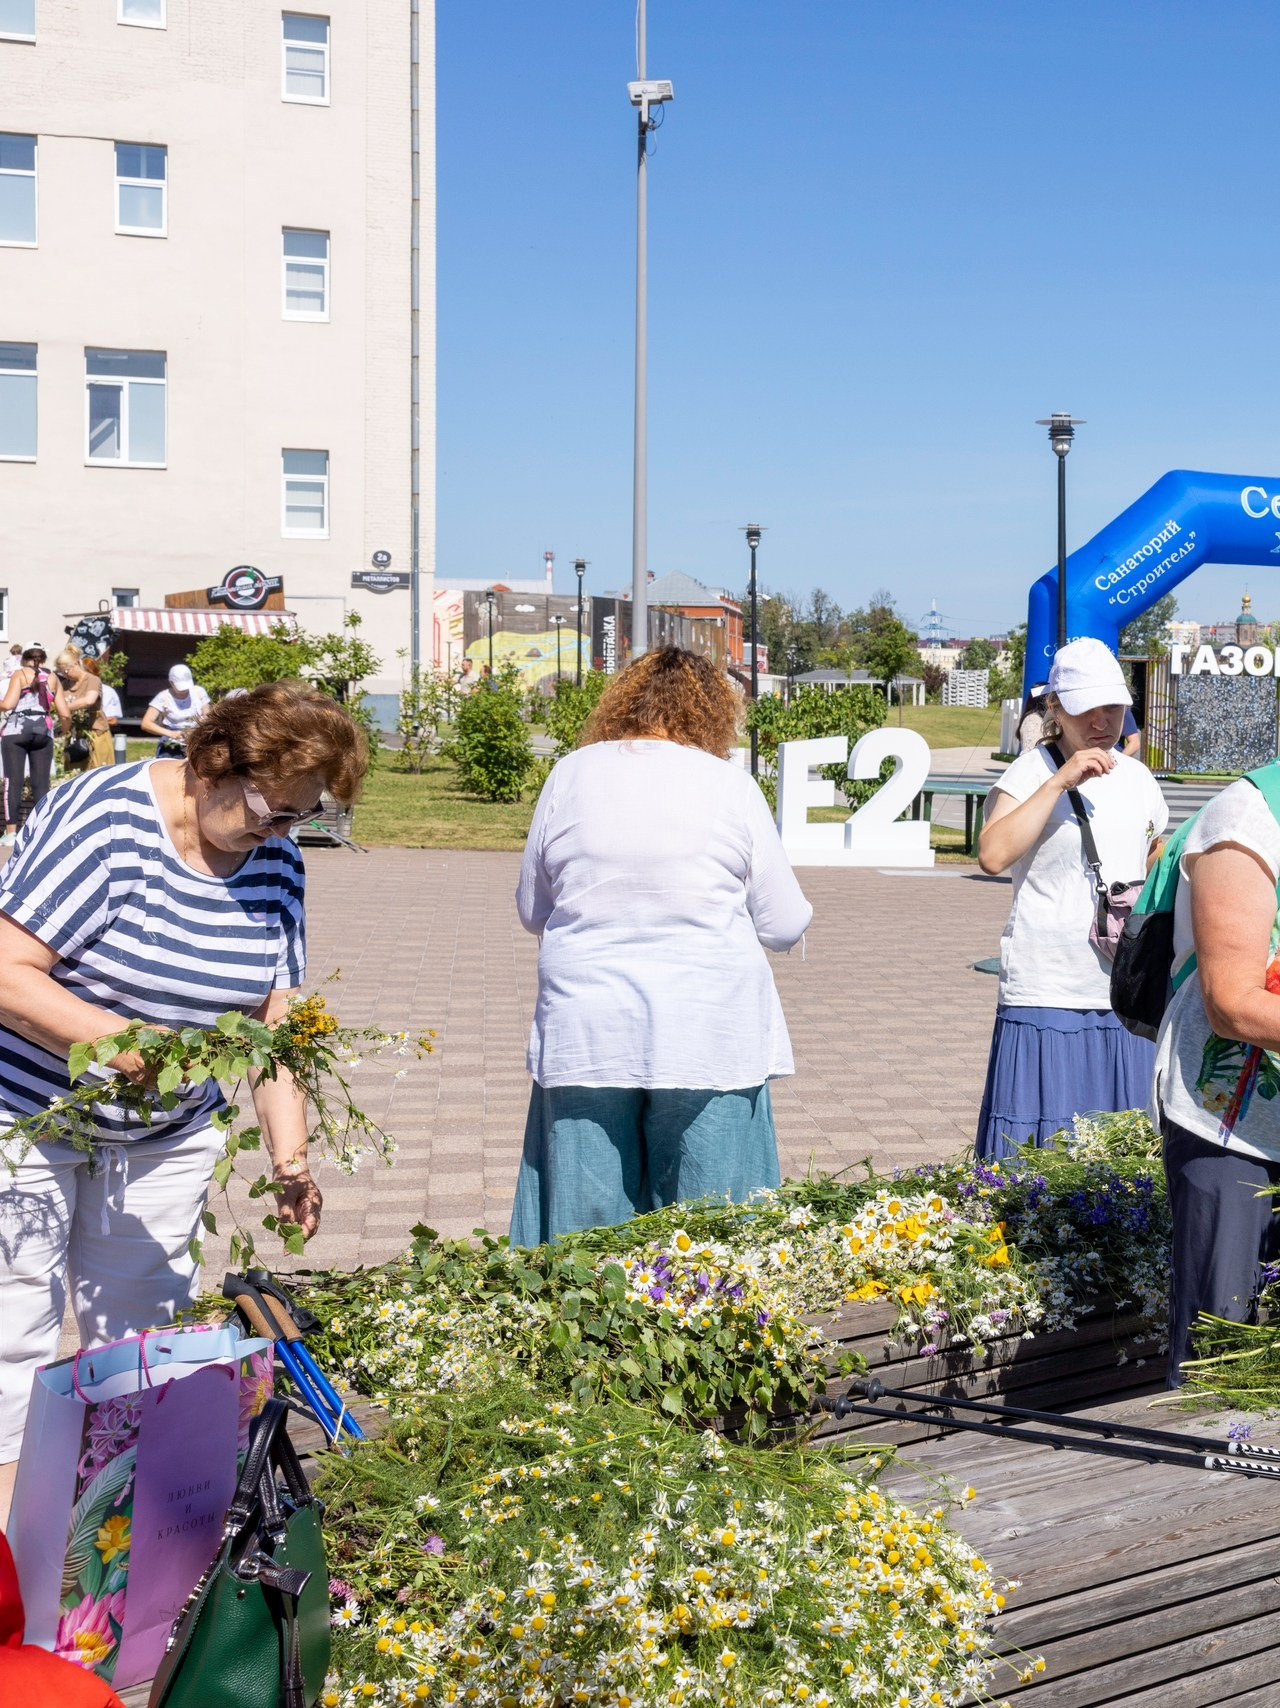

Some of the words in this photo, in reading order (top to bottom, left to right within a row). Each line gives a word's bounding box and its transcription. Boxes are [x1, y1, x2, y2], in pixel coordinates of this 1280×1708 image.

[1094, 519, 1182, 591] Санаторий
[167, 1480, 211, 1503] ЛЮБВИ
[185, 1503, 192, 1515] И
[157, 1511, 216, 1541] КРАСОТЫ
